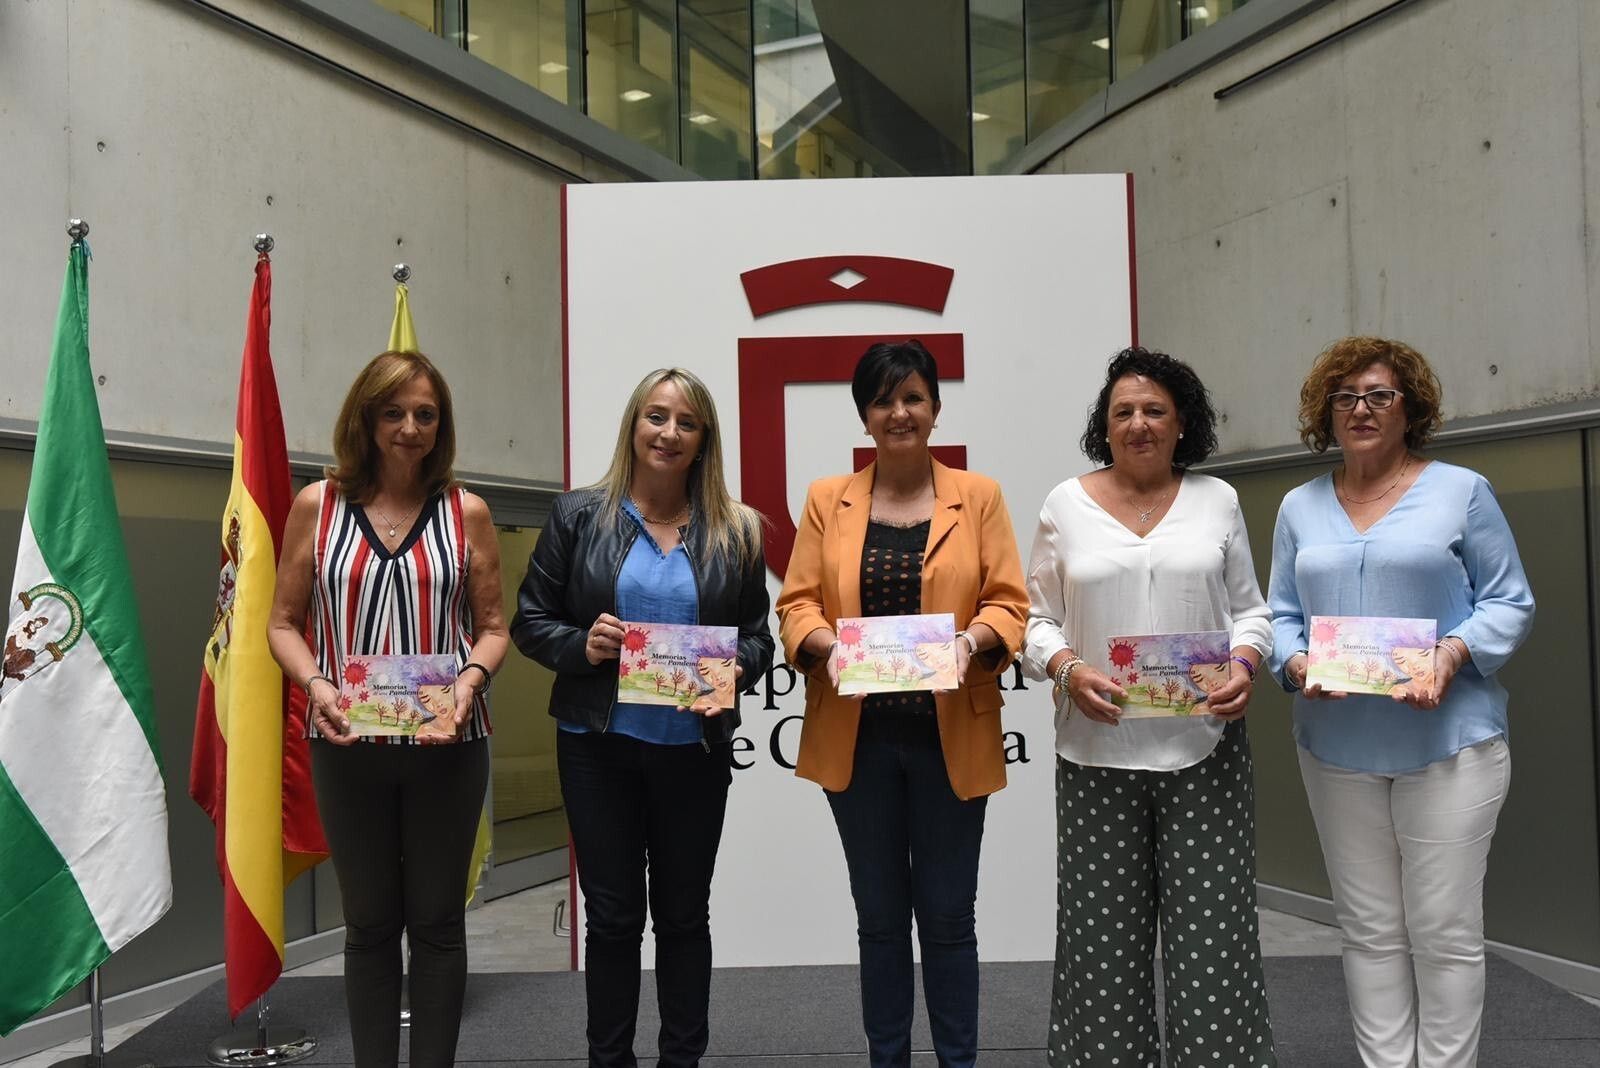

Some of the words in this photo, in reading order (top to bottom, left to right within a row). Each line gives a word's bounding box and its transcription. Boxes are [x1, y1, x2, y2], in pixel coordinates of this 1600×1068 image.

[652, 653, 687, 661] Memorias
[667, 659, 703, 667] Pandemia
[1142, 663, 1178, 671] Memorias
[1159, 669, 1196, 677] Pandemia
